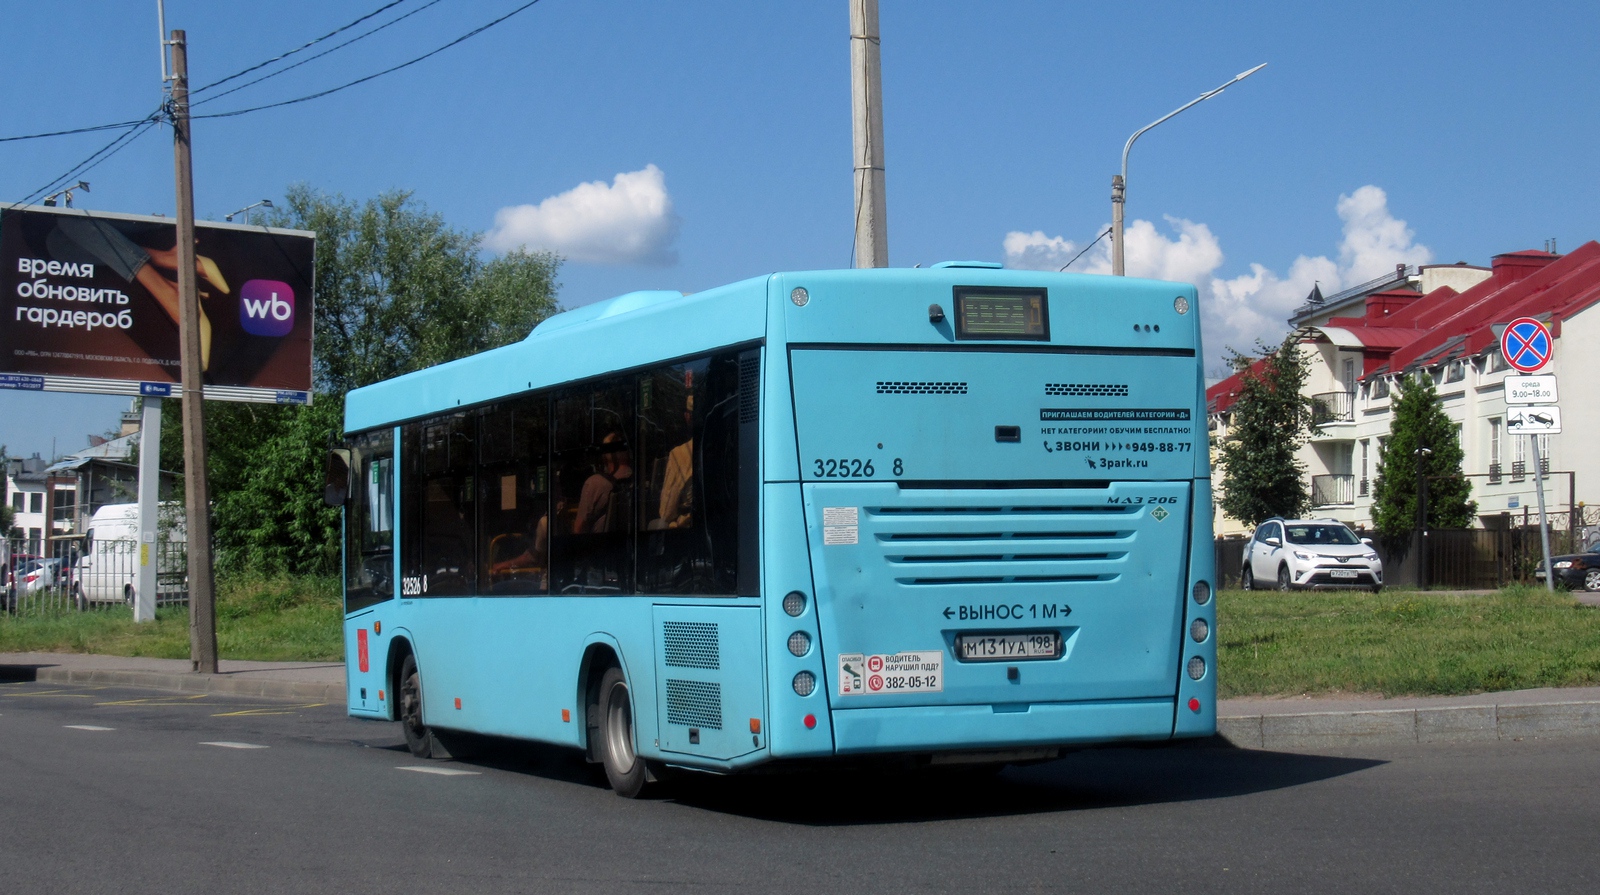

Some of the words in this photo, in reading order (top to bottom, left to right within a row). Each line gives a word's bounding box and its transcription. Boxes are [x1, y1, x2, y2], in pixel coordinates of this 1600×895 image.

[18, 257, 94, 278] время
[17, 279, 130, 305] обновить
[243, 292, 292, 320] wb
[16, 305, 133, 331] гардероб
[1093, 410, 1136, 419] ВОДИТЕЛЕЙ
[1055, 441, 1100, 451] ЗВОНИ
[1132, 442, 1191, 452] 949-88-77
[813, 458, 875, 478] 32526
[892, 457, 904, 477] 8
[1099, 457, 1148, 469] 3park.ru
[1107, 496, 1143, 504] МАЗ
[1147, 496, 1178, 504] 206
[402, 577, 421, 595] 32526
[423, 574, 429, 593] 8
[959, 604, 1024, 620] ВЫНОС
[1029, 604, 1036, 618] 1
[1042, 603, 1057, 618] М
[966, 637, 1026, 656] М131УА
[1029, 635, 1051, 649] 198
[885, 655, 921, 663] ВОДИТЕЛЬ
[885, 664, 920, 672] НАРУШИЛ
[920, 663, 939, 672] ПДД?
[885, 675, 937, 689] 382-05-12
